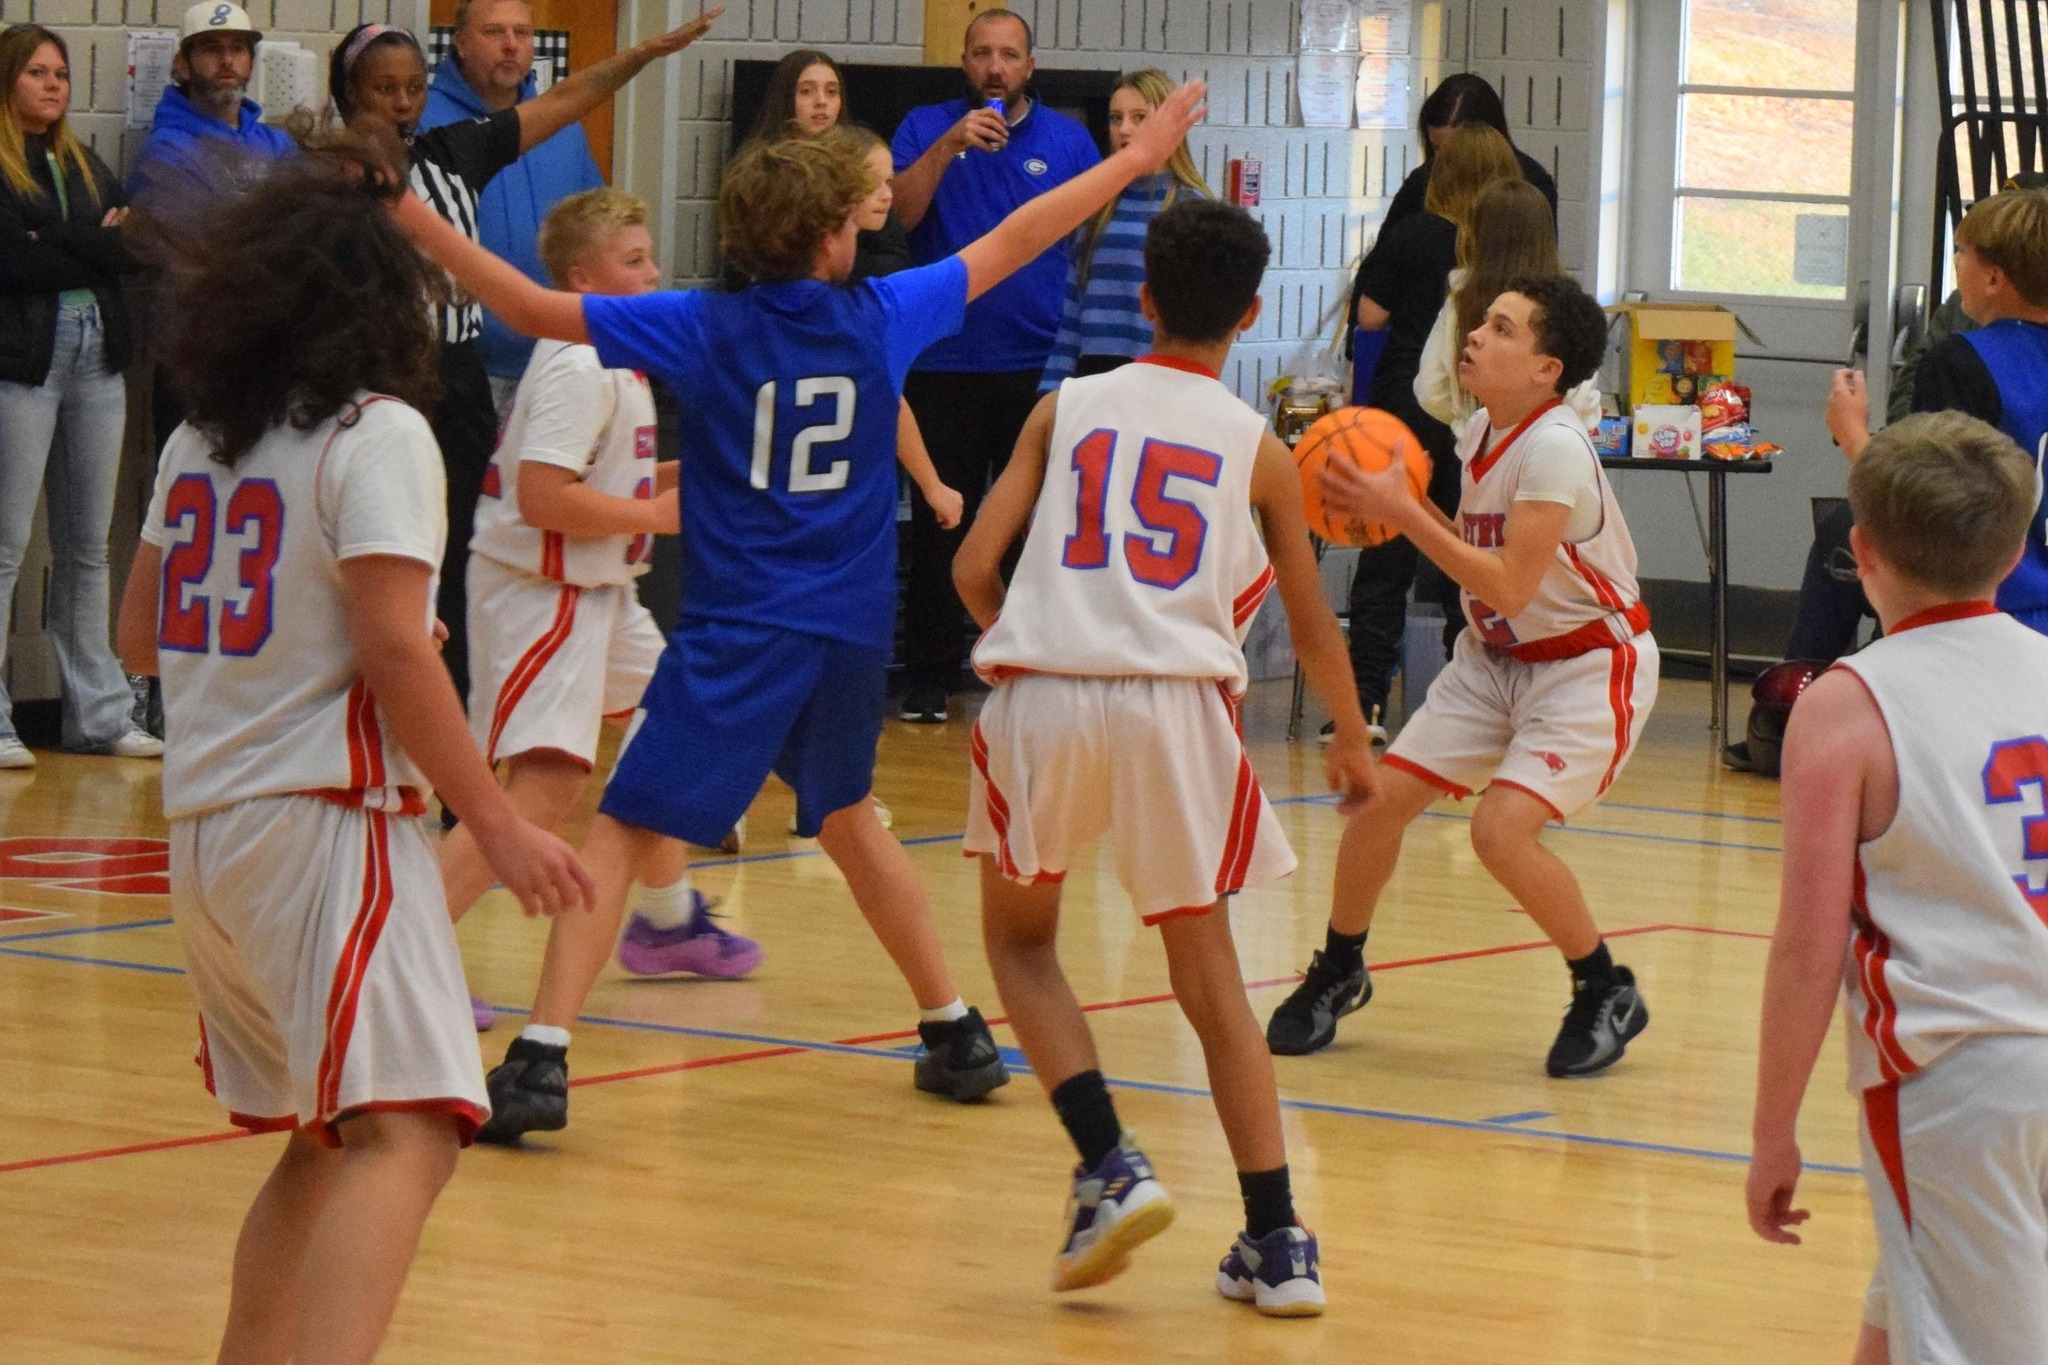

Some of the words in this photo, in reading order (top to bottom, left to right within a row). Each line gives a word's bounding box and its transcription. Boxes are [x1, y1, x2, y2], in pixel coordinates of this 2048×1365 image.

[751, 376, 857, 492] 12
[1061, 427, 1224, 591] 15
[159, 472, 285, 657] 23
